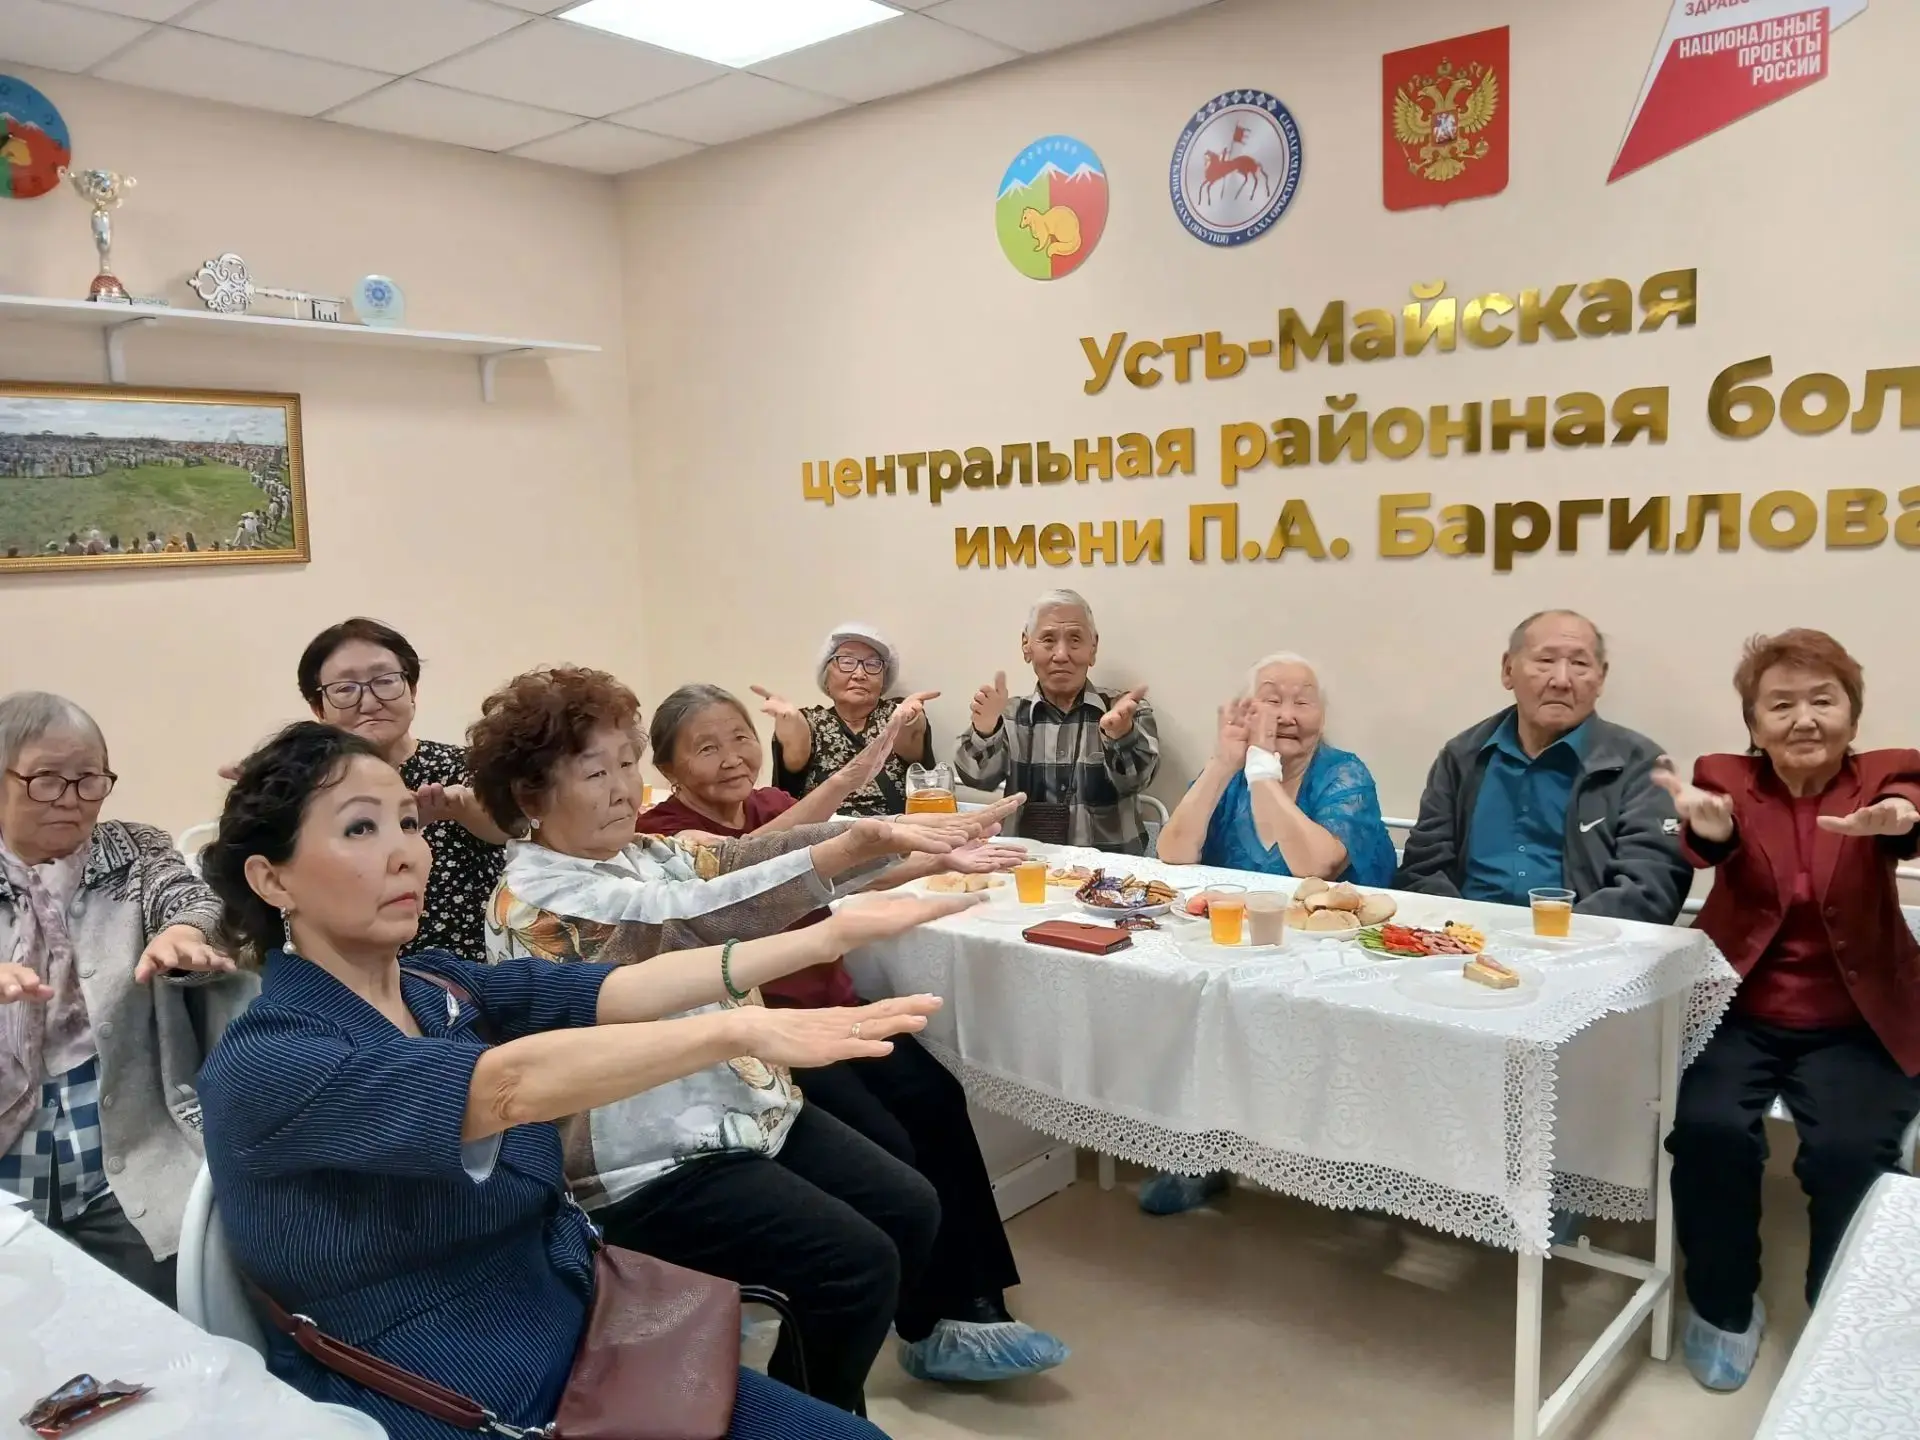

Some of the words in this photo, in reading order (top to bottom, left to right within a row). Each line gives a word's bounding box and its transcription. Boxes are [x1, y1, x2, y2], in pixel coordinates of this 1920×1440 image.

[1685, 0, 1750, 16] ЗДРАВ
[1679, 11, 1823, 59] НАЦИОНАЛЬНЫЕ
[1737, 33, 1822, 68] ПРОЕКТЫ
[1752, 54, 1821, 86] РОССИИ
[1080, 268, 1698, 395] Усть-Майская
[801, 427, 1195, 506] центральная
[1220, 386, 1670, 487] районная
[1707, 355, 1920, 440] бол
[954, 517, 1164, 569] имени
[1188, 498, 1350, 562] П.А.
